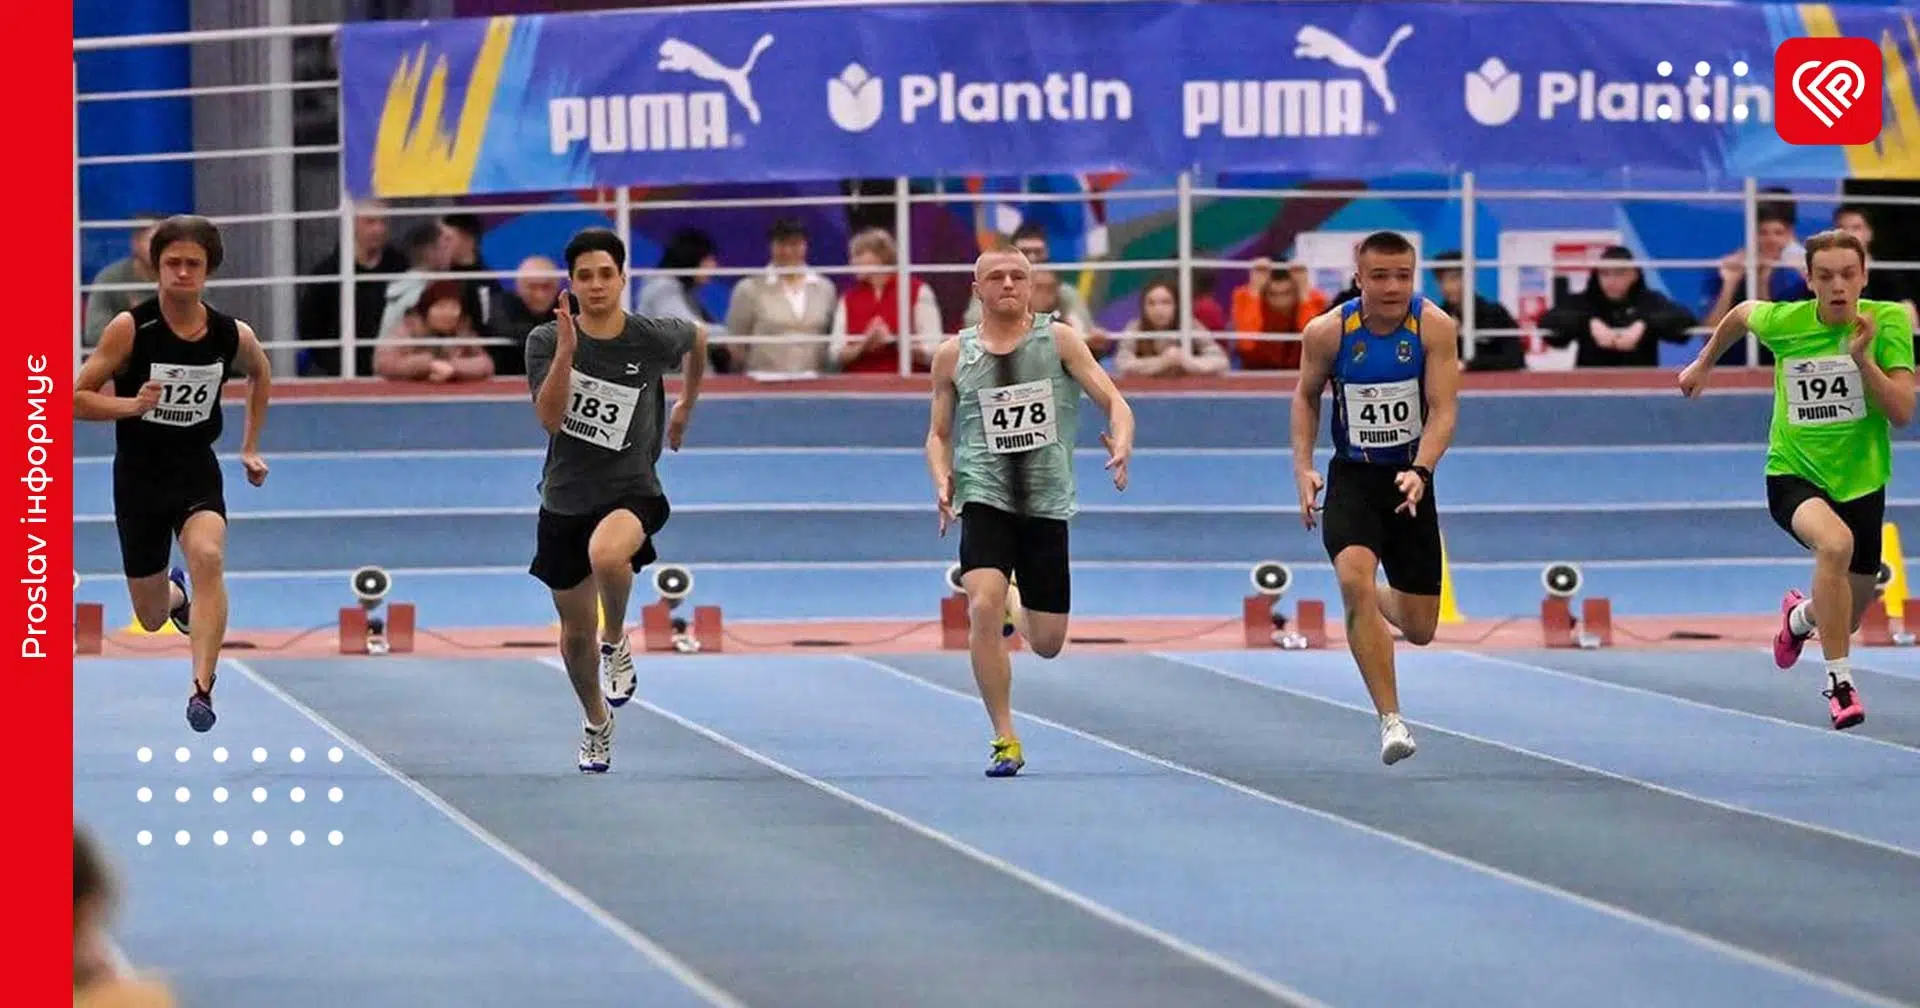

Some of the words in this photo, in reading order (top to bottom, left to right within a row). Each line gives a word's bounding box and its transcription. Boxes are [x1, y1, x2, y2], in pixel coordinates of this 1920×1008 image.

[1182, 79, 1364, 138] PUMA
[550, 91, 728, 155] PUMA
[163, 383, 208, 405] 126
[1797, 375, 1849, 401] 194
[154, 407, 193, 423] PUMA
[571, 392, 619, 424] 183
[992, 402, 1046, 430] 478
[1360, 401, 1409, 425] 410
[1797, 404, 1838, 420] PUMA
[995, 432, 1034, 449] PUMA
[1359, 429, 1399, 443] PUMA
